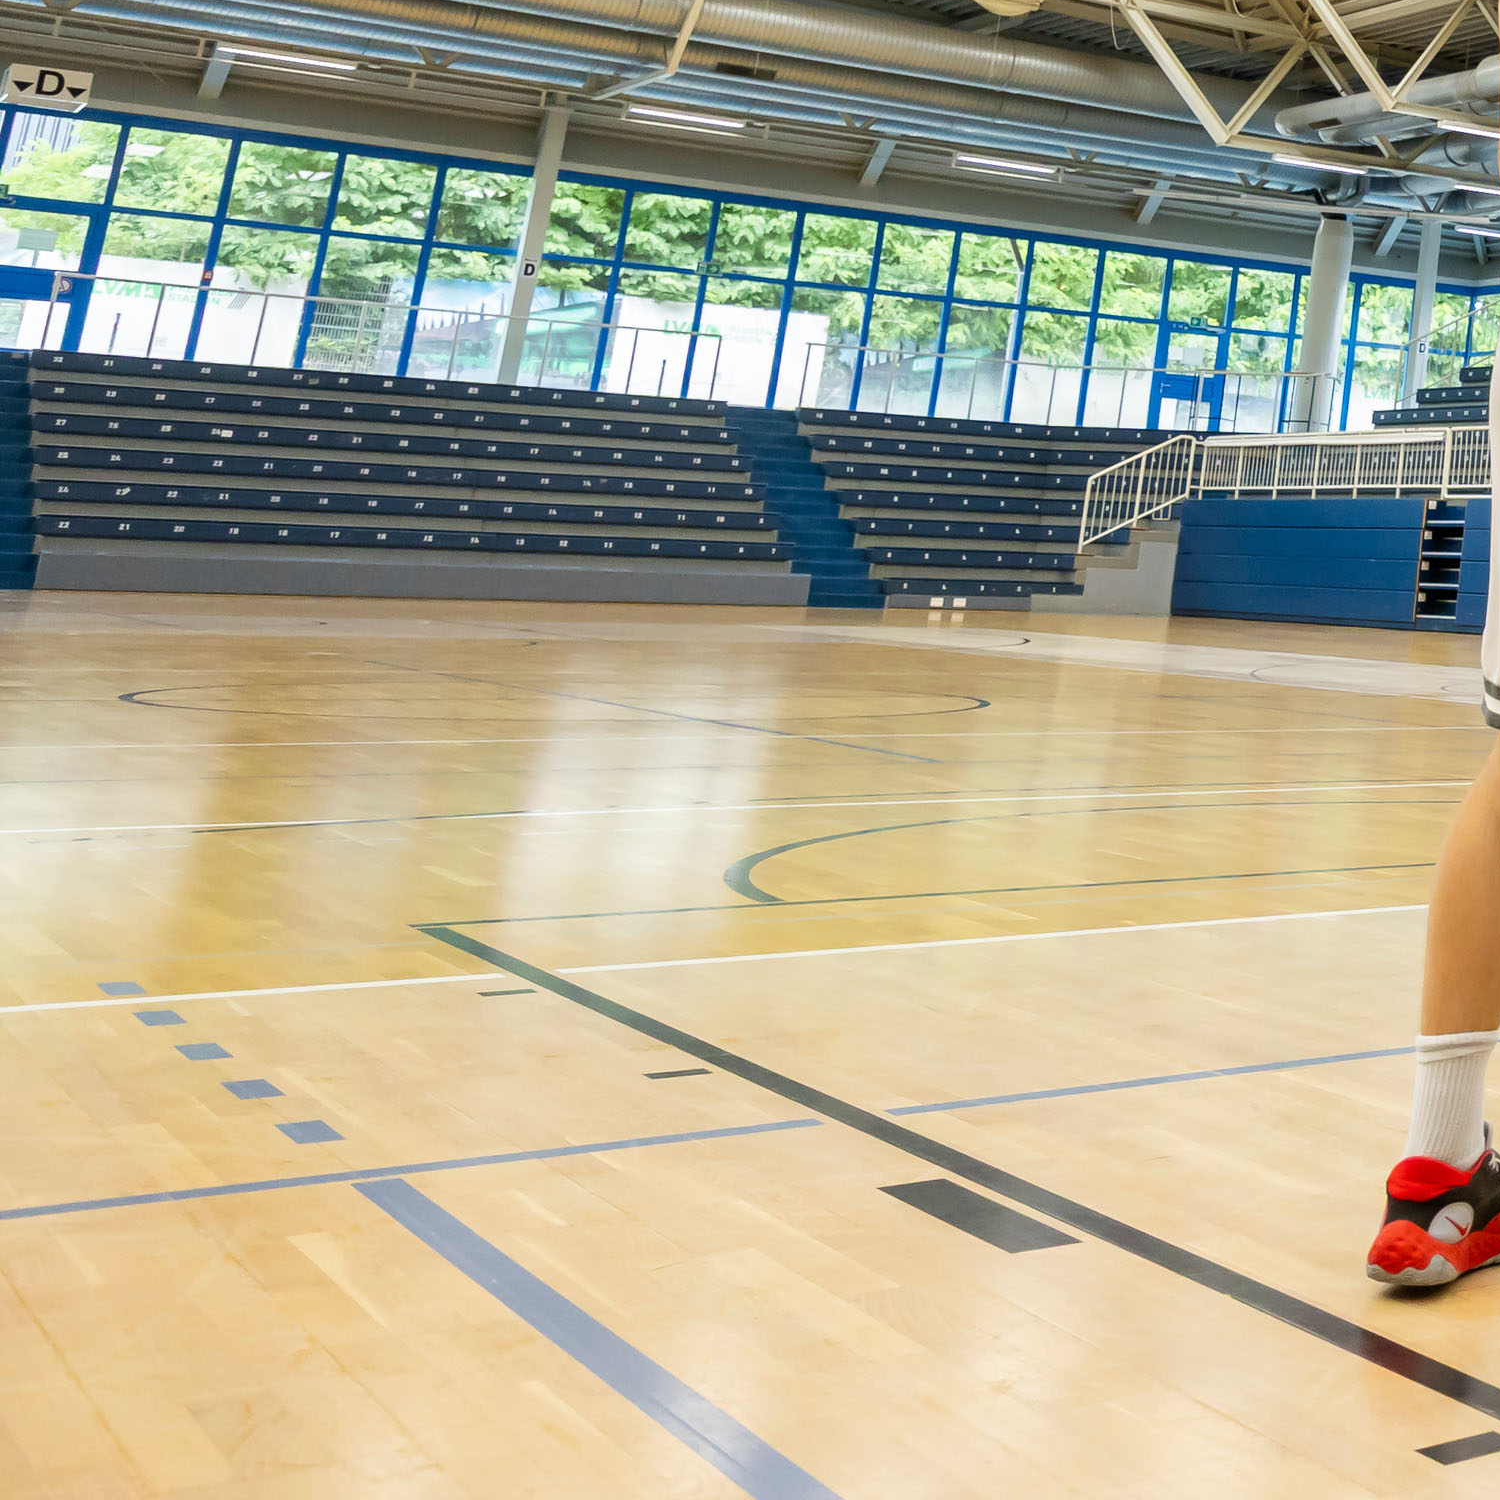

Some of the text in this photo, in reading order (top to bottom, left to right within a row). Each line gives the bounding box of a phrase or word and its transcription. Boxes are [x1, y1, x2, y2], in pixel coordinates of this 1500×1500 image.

[35, 70, 65, 96] D
[523, 262, 535, 276] D
[1419, 343, 1426, 353] D
